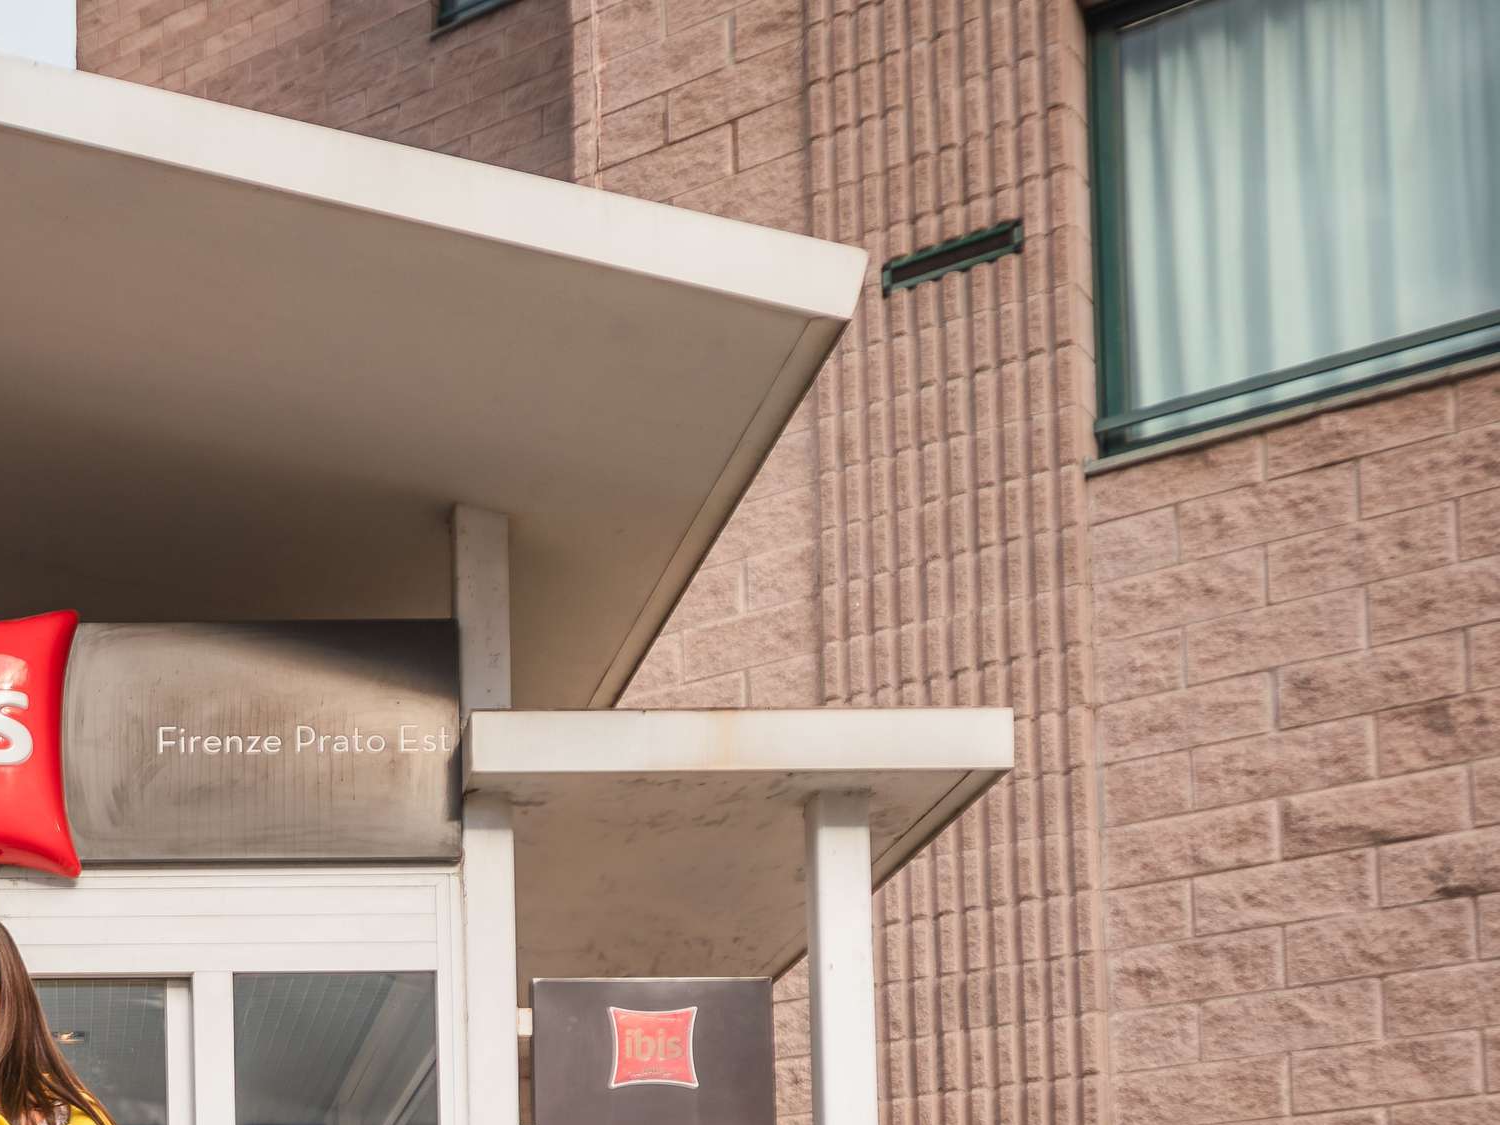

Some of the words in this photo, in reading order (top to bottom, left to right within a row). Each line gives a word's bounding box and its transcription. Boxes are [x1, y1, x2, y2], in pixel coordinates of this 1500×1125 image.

[157, 726, 282, 754] Firenze
[295, 725, 386, 753] Prato
[399, 724, 451, 752] Est
[624, 1028, 684, 1061] ibis
